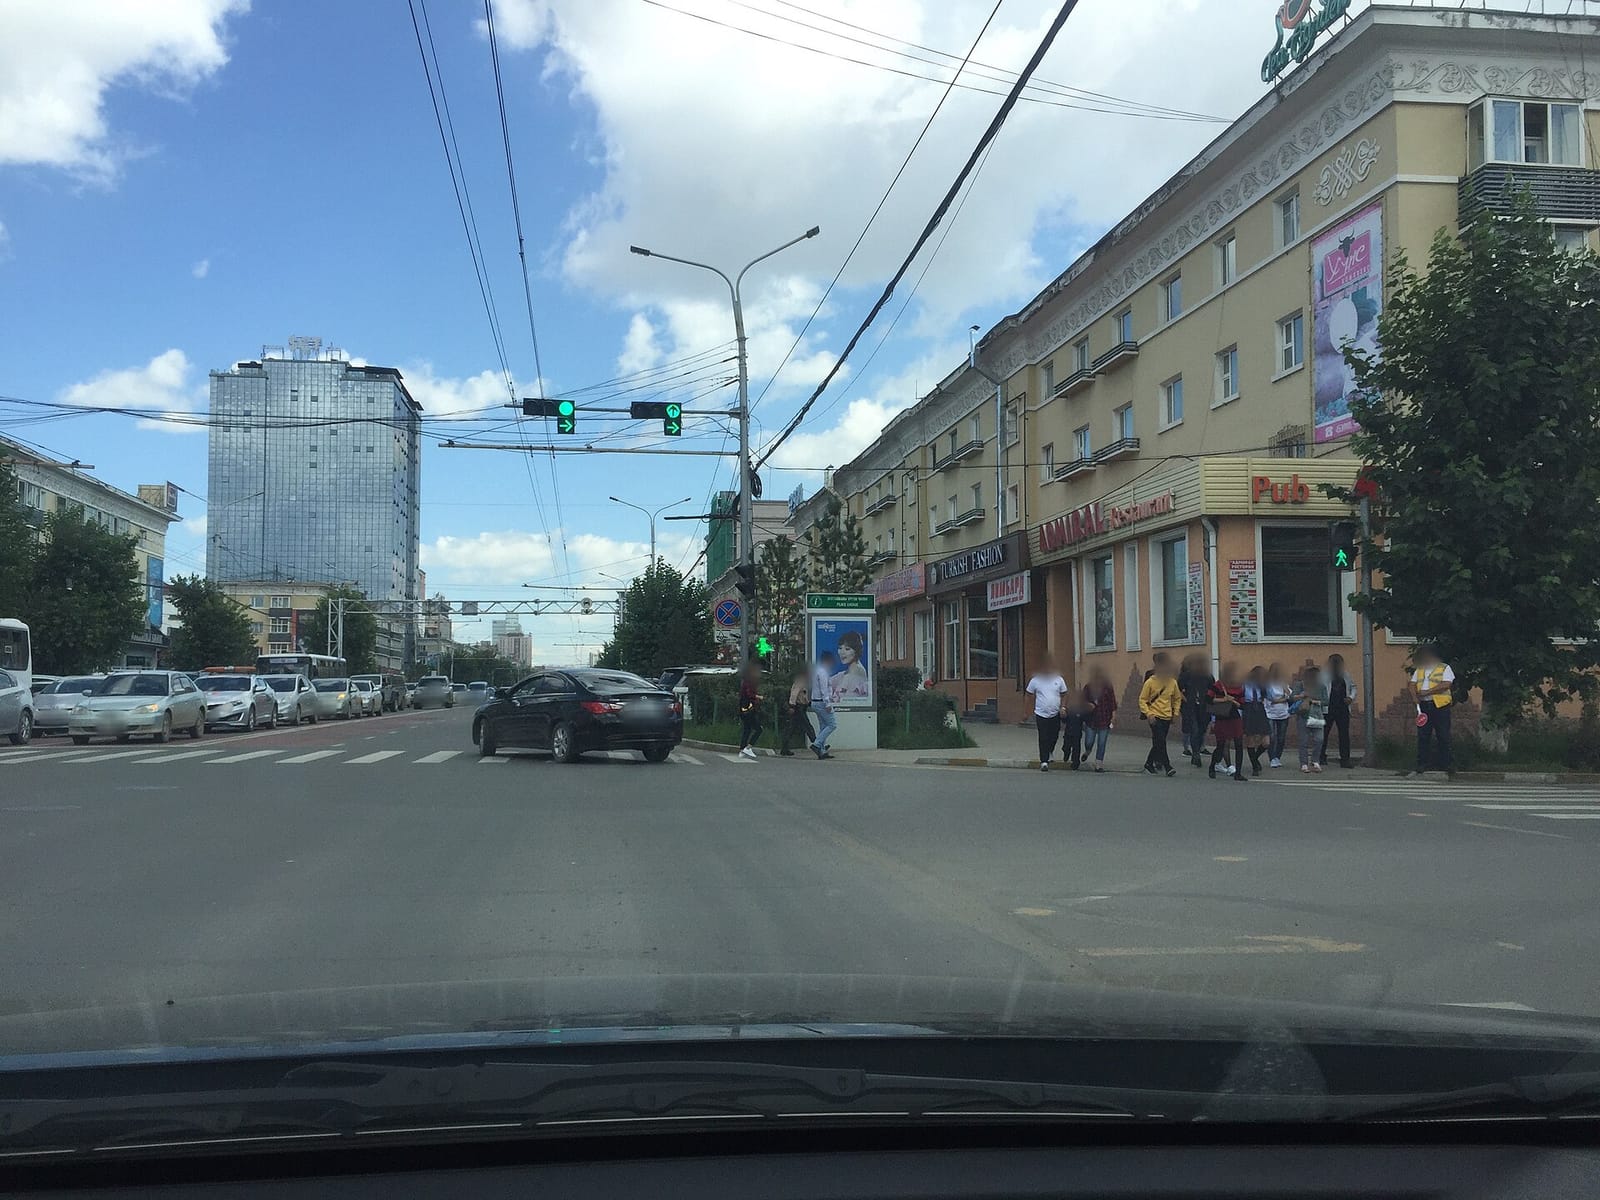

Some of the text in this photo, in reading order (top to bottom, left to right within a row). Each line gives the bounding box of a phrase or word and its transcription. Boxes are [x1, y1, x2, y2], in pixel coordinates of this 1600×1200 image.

[1252, 474, 1310, 503] Pub
[1040, 488, 1175, 552] ADMIRAL Restaurant
[940, 544, 1004, 580] TURKISH FASHION
